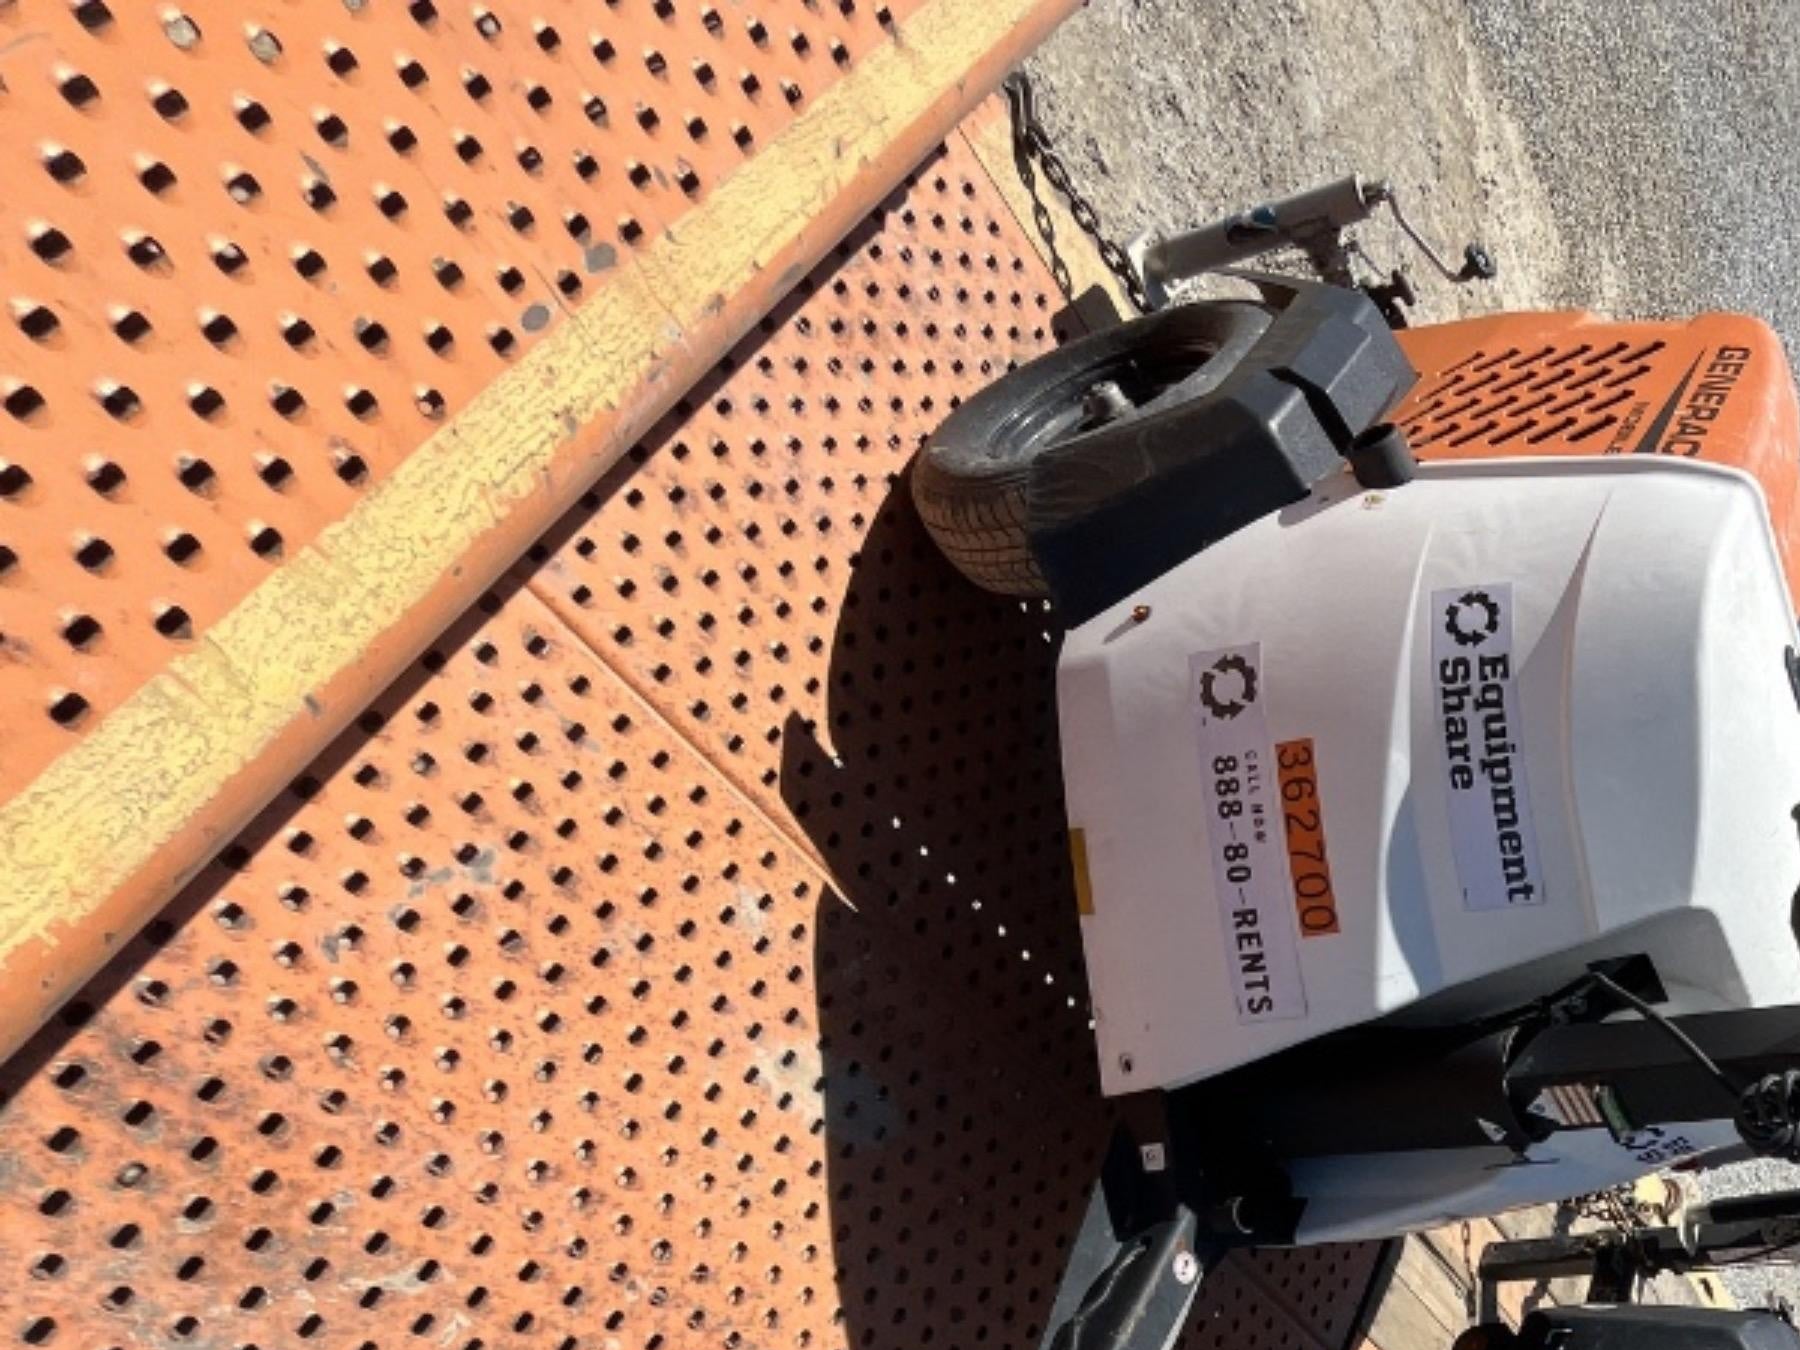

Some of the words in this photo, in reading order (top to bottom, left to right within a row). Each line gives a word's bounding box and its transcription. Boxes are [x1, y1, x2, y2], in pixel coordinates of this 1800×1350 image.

[1661, 347, 1751, 456] GENERAC
[1243, 750, 1260, 795] CALL
[1437, 656, 1475, 790] Share
[1475, 654, 1535, 903] Equipment
[1212, 755, 1272, 1015] 888-80-RENTS
[1276, 743, 1337, 932] 362700
